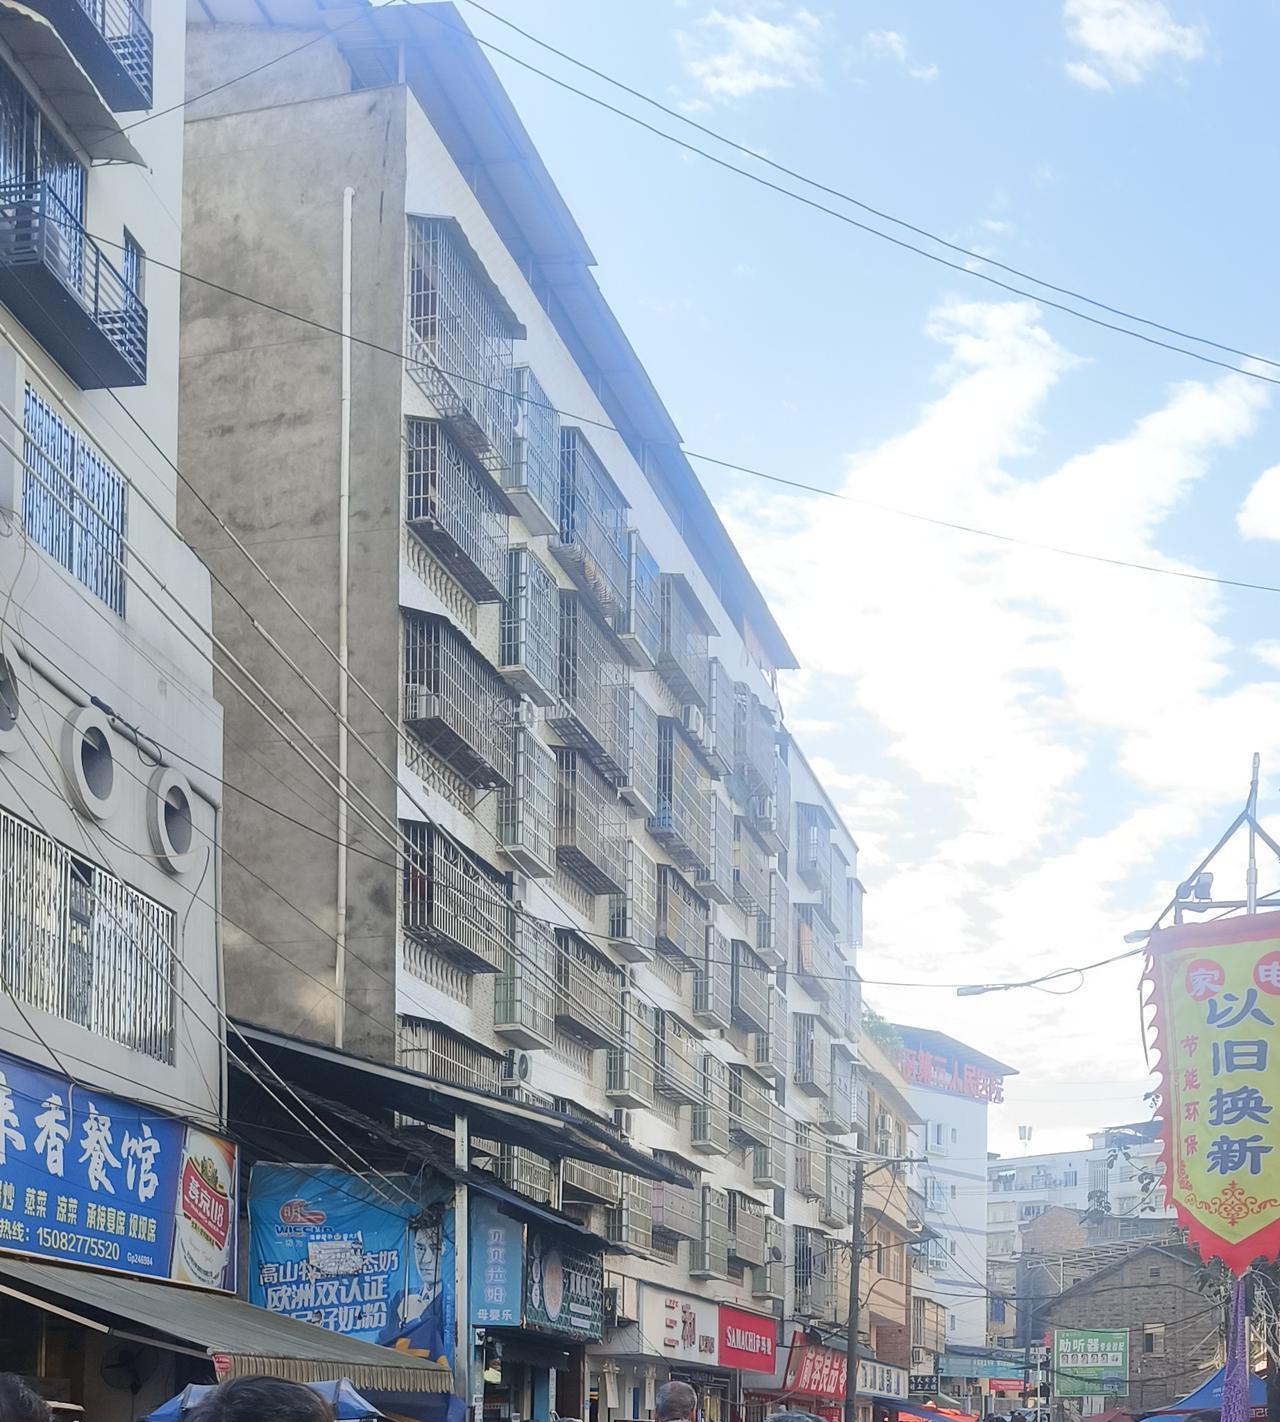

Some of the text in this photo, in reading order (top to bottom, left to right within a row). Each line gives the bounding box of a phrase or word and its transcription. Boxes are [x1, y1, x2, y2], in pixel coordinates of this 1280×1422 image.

[1190, 968, 1220, 996] 家
[1181, 1034, 1200, 1156] 节能环保
[1206, 988, 1275, 1175] 以旧换新
[0, 1180, 15, 1211] 炒
[24, 1187, 47, 1218] 蒸菜
[56, 1195, 78, 1224] 凉菜
[86, 1202, 126, 1236] 承接宴席
[36, 1227, 120, 1261] 15082775520
[267, 1275, 388, 1311] 欧洲双认证
[1059, 1338, 1099, 1353] 助听器
